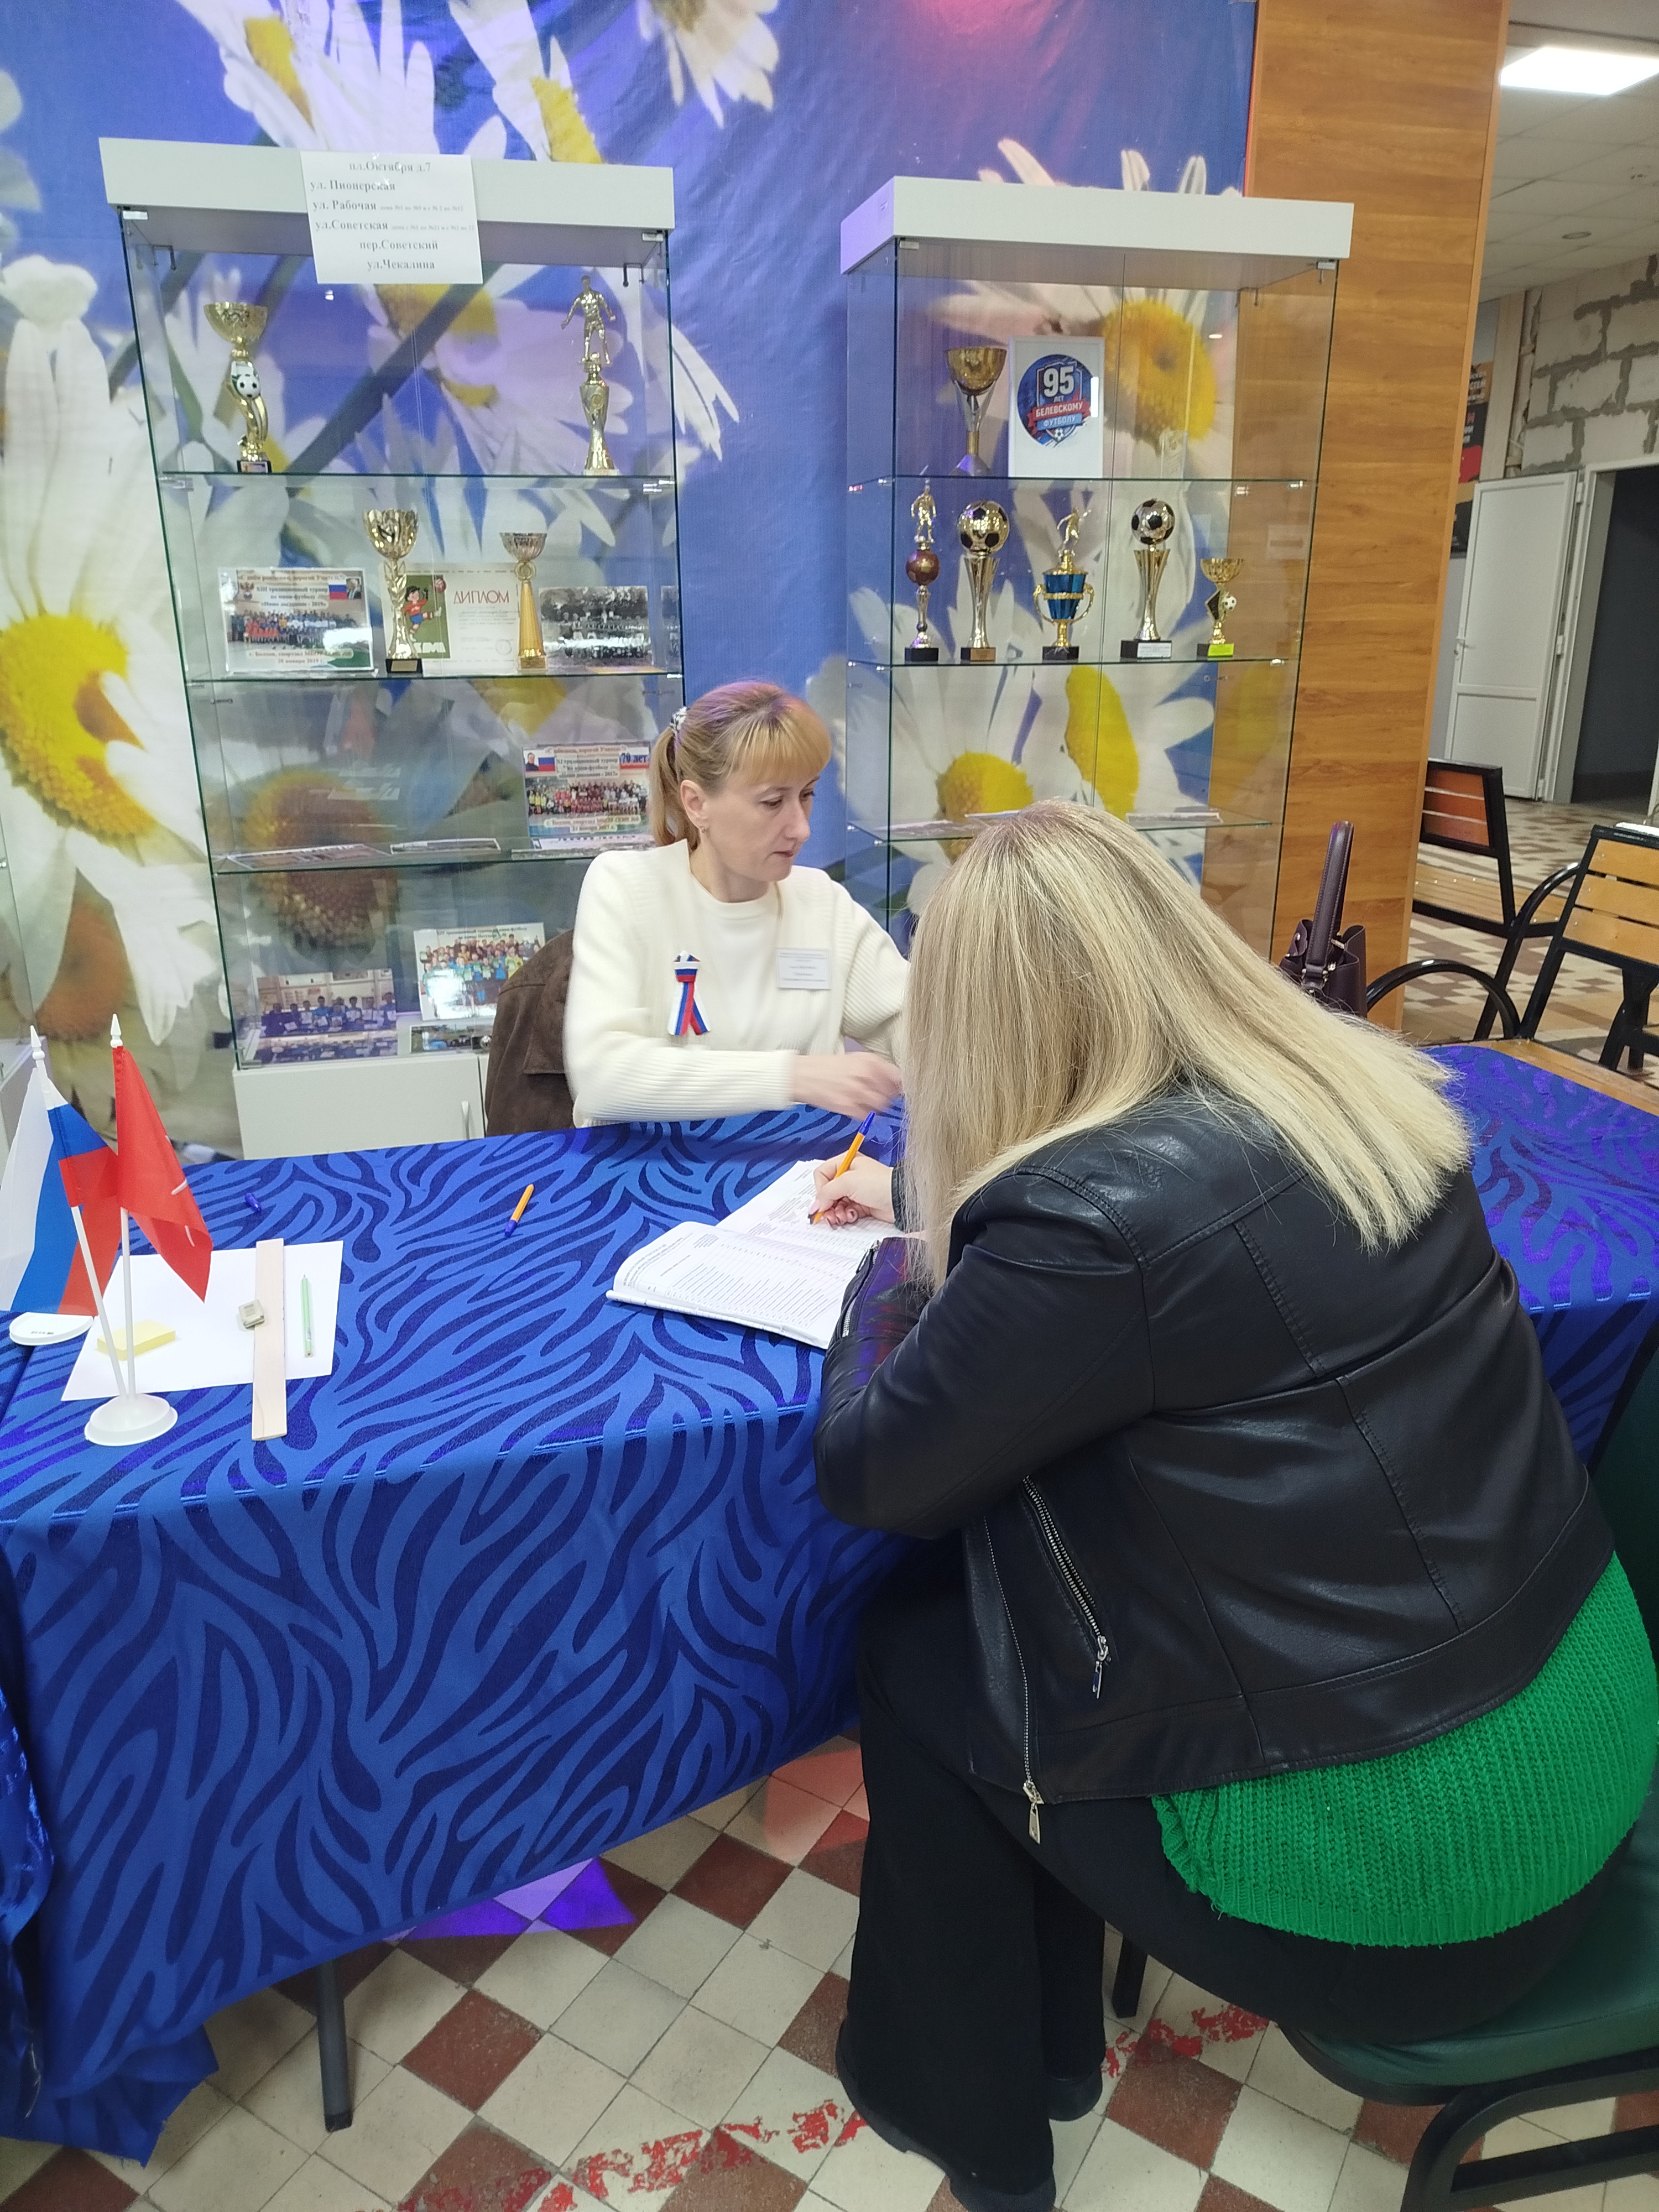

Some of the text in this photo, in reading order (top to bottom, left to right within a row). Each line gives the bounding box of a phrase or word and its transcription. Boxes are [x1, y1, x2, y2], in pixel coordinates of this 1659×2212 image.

[349, 160, 431, 174] пл.Октября д.7
[310, 180, 395, 192] ул. Пионерская
[313, 201, 328, 211] ул.
[332, 200, 377, 211] Рабочая
[315, 219, 388, 232] ул.Советская
[359, 238, 438, 252] пер.Советский
[367, 259, 435, 271] ул.Чекалина
[1043, 366, 1074, 398] 95
[1035, 401, 1083, 418] БЕЛЕВСКОМУ
[1043, 415, 1076, 427] ФУТБОЛУ
[453, 590, 510, 604] ДИПЛОМ
[633, 754, 648, 763] лет
